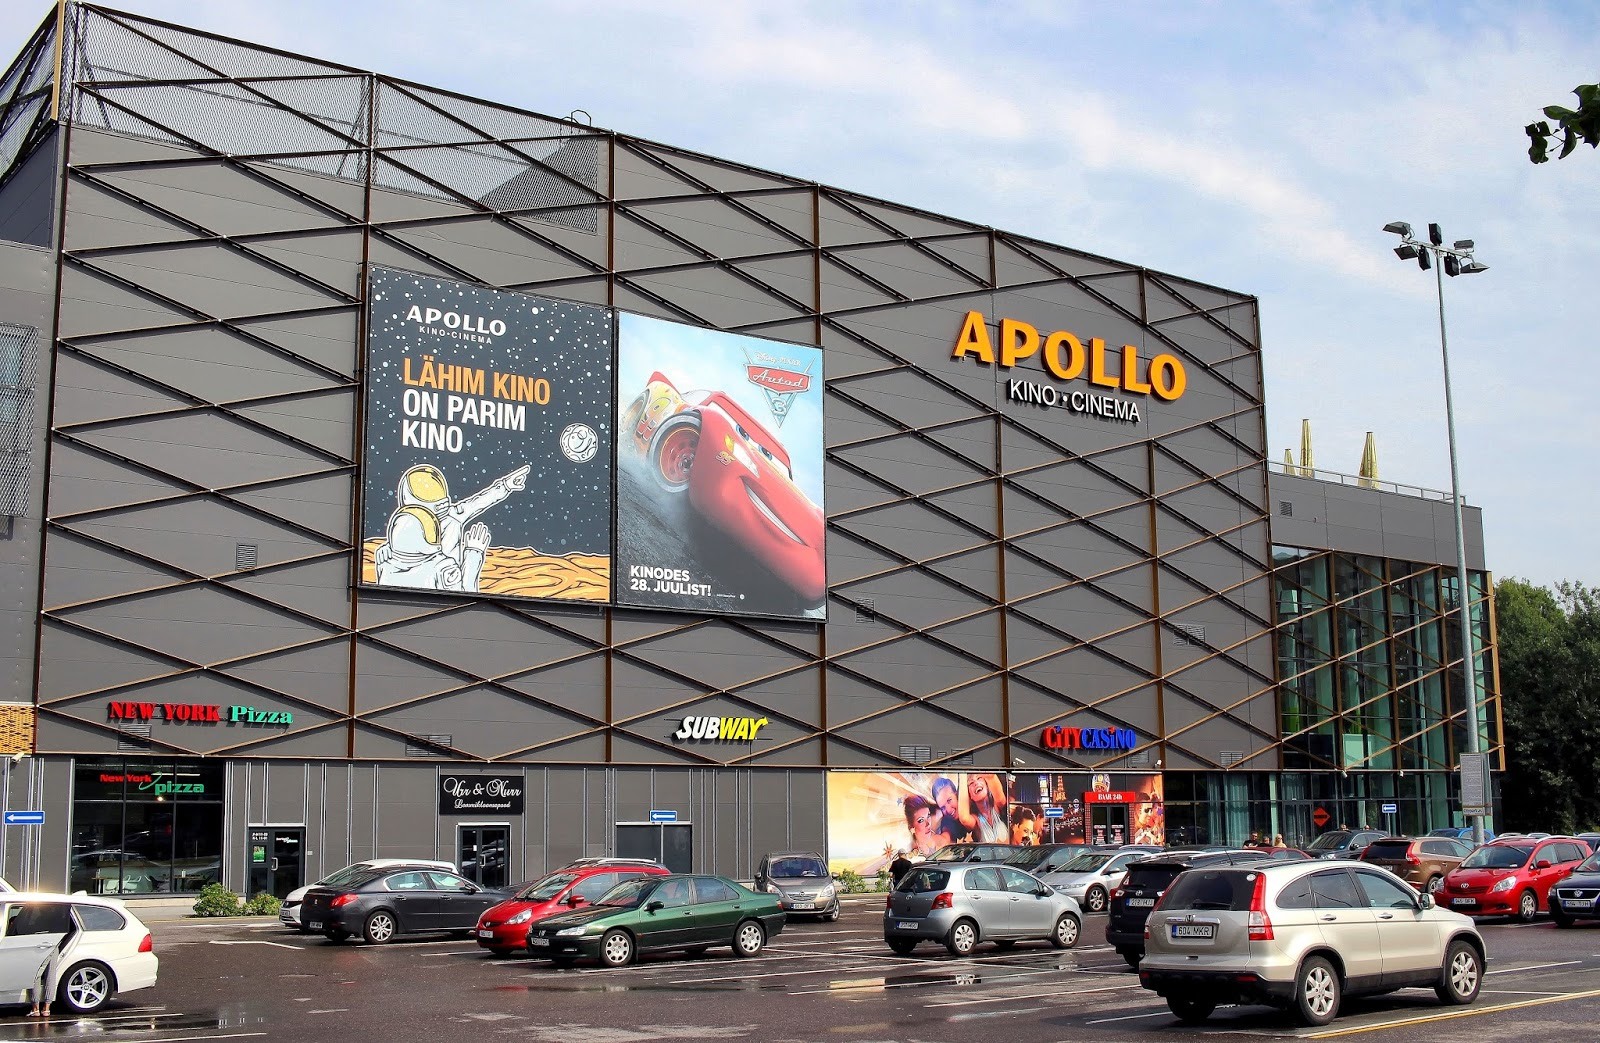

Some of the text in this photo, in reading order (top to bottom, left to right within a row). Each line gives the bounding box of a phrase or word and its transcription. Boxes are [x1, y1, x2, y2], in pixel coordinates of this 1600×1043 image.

[406, 305, 507, 336] APOLLO
[951, 310, 1187, 401] APOLLO
[404, 355, 551, 405] LÄHIM KINO
[752, 369, 804, 388] Autod
[403, 388, 526, 432] ON PARIM
[1008, 378, 1141, 423] KINO CINEMA
[402, 419, 463, 453] KINO
[630, 565, 690, 581] KINODES
[630, 578, 712, 597] 28. JUULIST!
[109, 701, 294, 724] NEW YORK Pizza
[675, 716, 769, 740] SUBWAY
[100, 774, 152, 783] New York
[154, 780, 205, 796] pizza
[472, 783, 485, 795] &
